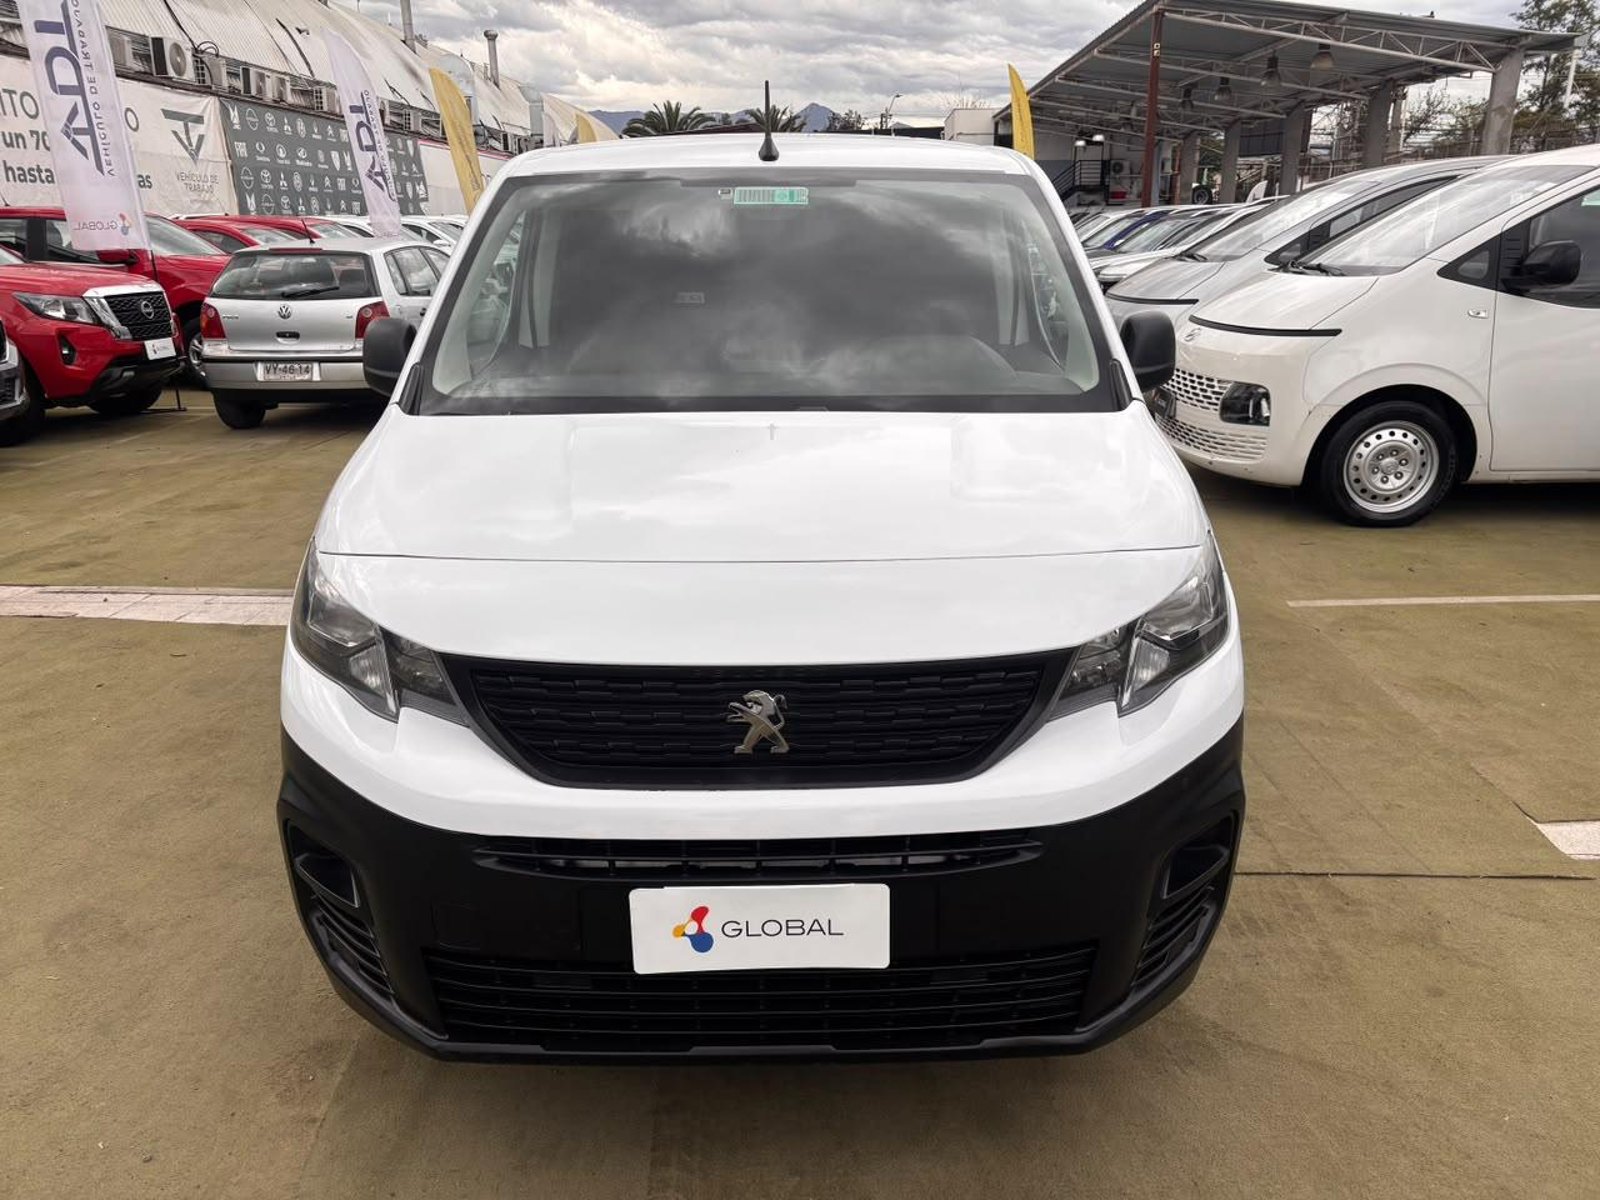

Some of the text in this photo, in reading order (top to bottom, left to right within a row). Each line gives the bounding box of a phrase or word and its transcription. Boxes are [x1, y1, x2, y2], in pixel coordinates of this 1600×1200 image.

[1, 131, 27, 150] un
[3, 159, 55, 184] hasta
[721, 918, 844, 938] GLOBAL
